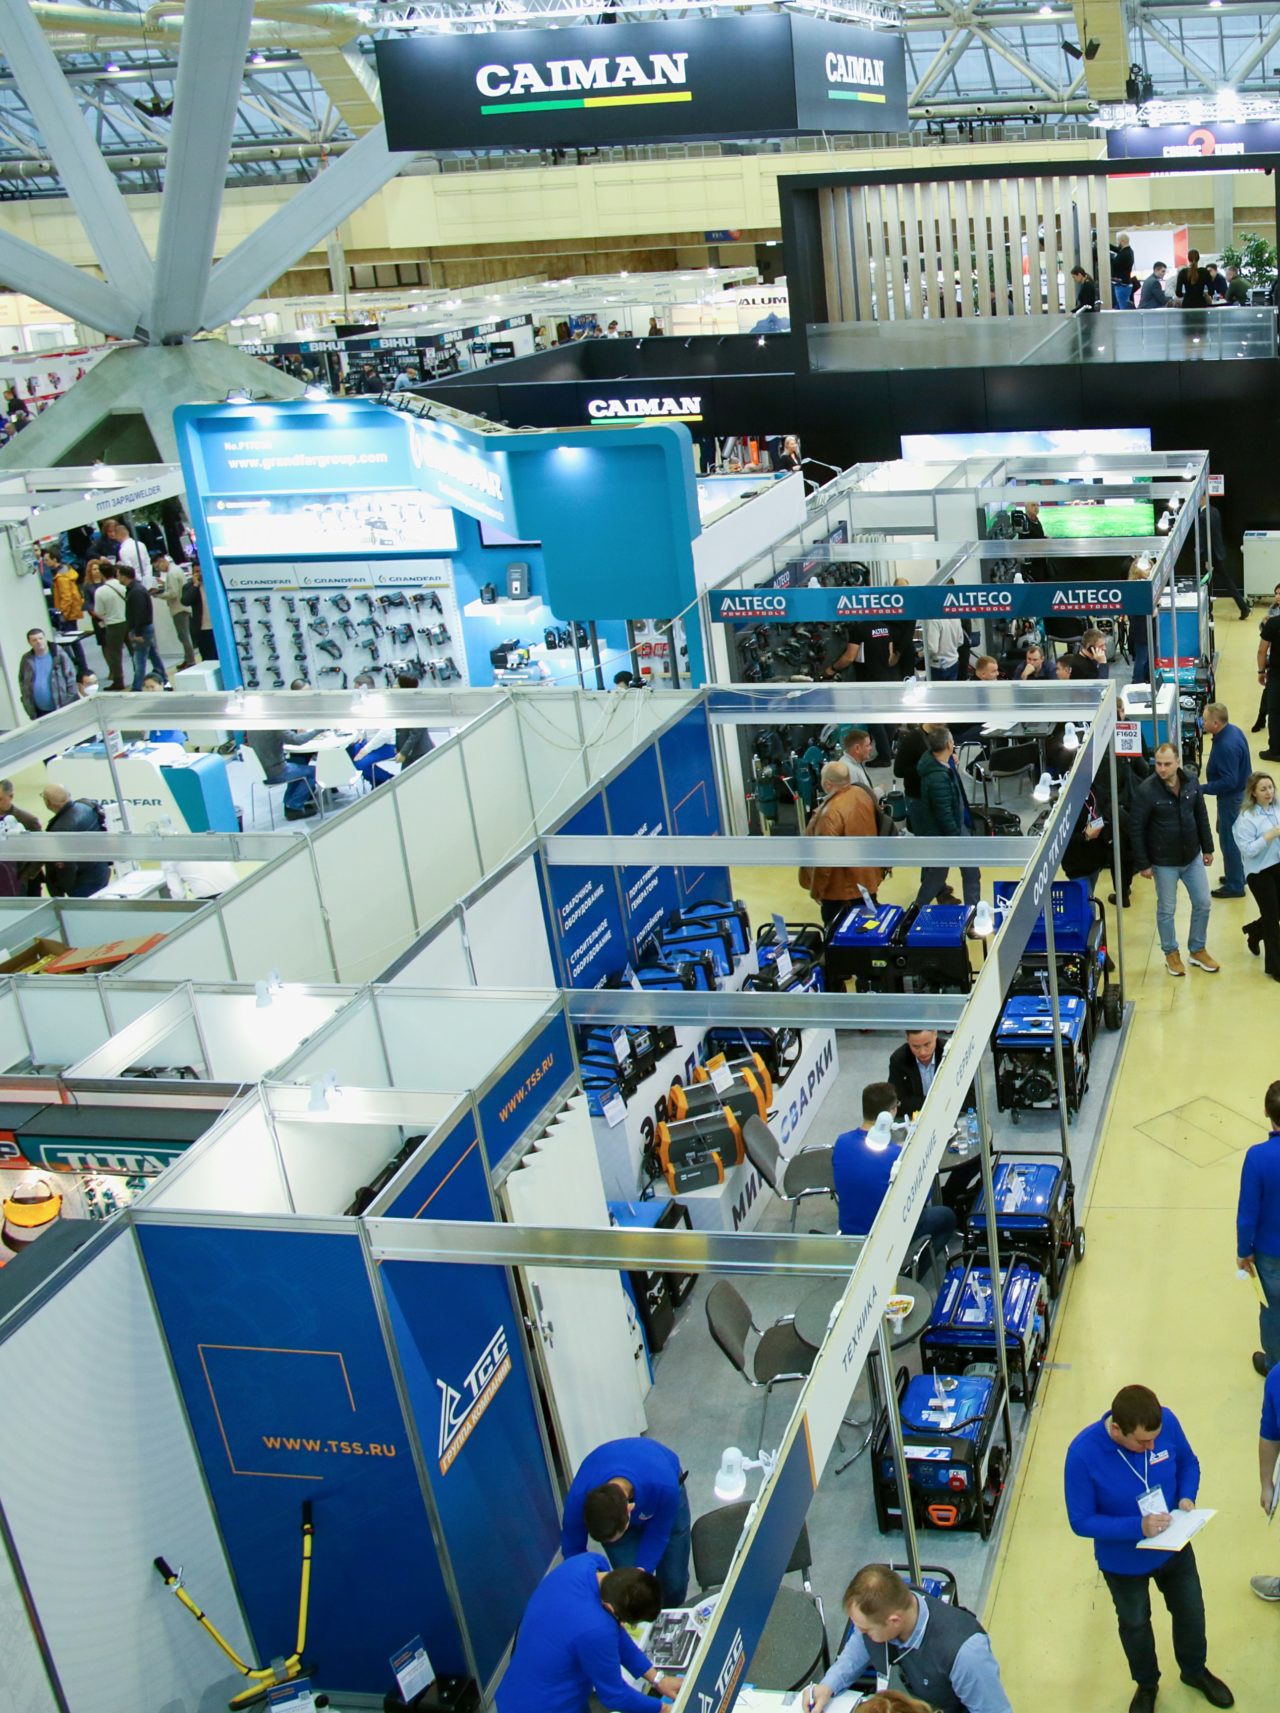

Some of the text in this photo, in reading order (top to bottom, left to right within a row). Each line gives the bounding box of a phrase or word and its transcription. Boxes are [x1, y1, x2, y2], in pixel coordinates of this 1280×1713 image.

[476, 53, 688, 97] CAIMAN
[825, 52, 885, 87] CAIMAN
[308, 341, 346, 351] BIHUI
[380, 338, 416, 348] BIHUI
[447, 330, 463, 343] BIHUI
[588, 397, 701, 418] CAIMAN
[228, 452, 388, 470] www.grandfargroup.com
[720, 596, 786, 611] ALTECO
[837, 594, 904, 608] ALTECO
[943, 591, 1012, 606] ALTECO
[1052, 589, 1122, 604] ALTECO
[93, 798, 162, 806] RANFAR
[561, 880, 593, 917] СВАРОЧНОЕ
[1033, 861, 1048, 906] ООО
[564, 883, 605, 931] ОБОРУДОВАНИЕ
[570, 918, 609, 965] СТРОИТЕЛЬНОЕ
[572, 929, 613, 978] ОБОРУДОВАНИЕ
[499, 1052, 554, 1122] WWW.TSS.RU
[780, 1039, 833, 1145] СВАРКИ
[902, 1128, 937, 1223] СОЗИДАНИЕ
[842, 1284, 878, 1373] ТЕХНИКА
[441, 1361, 511, 1470] ГРУППА КОМПАНИЙ
[262, 1436, 397, 1457] WWW.TSS.RU
